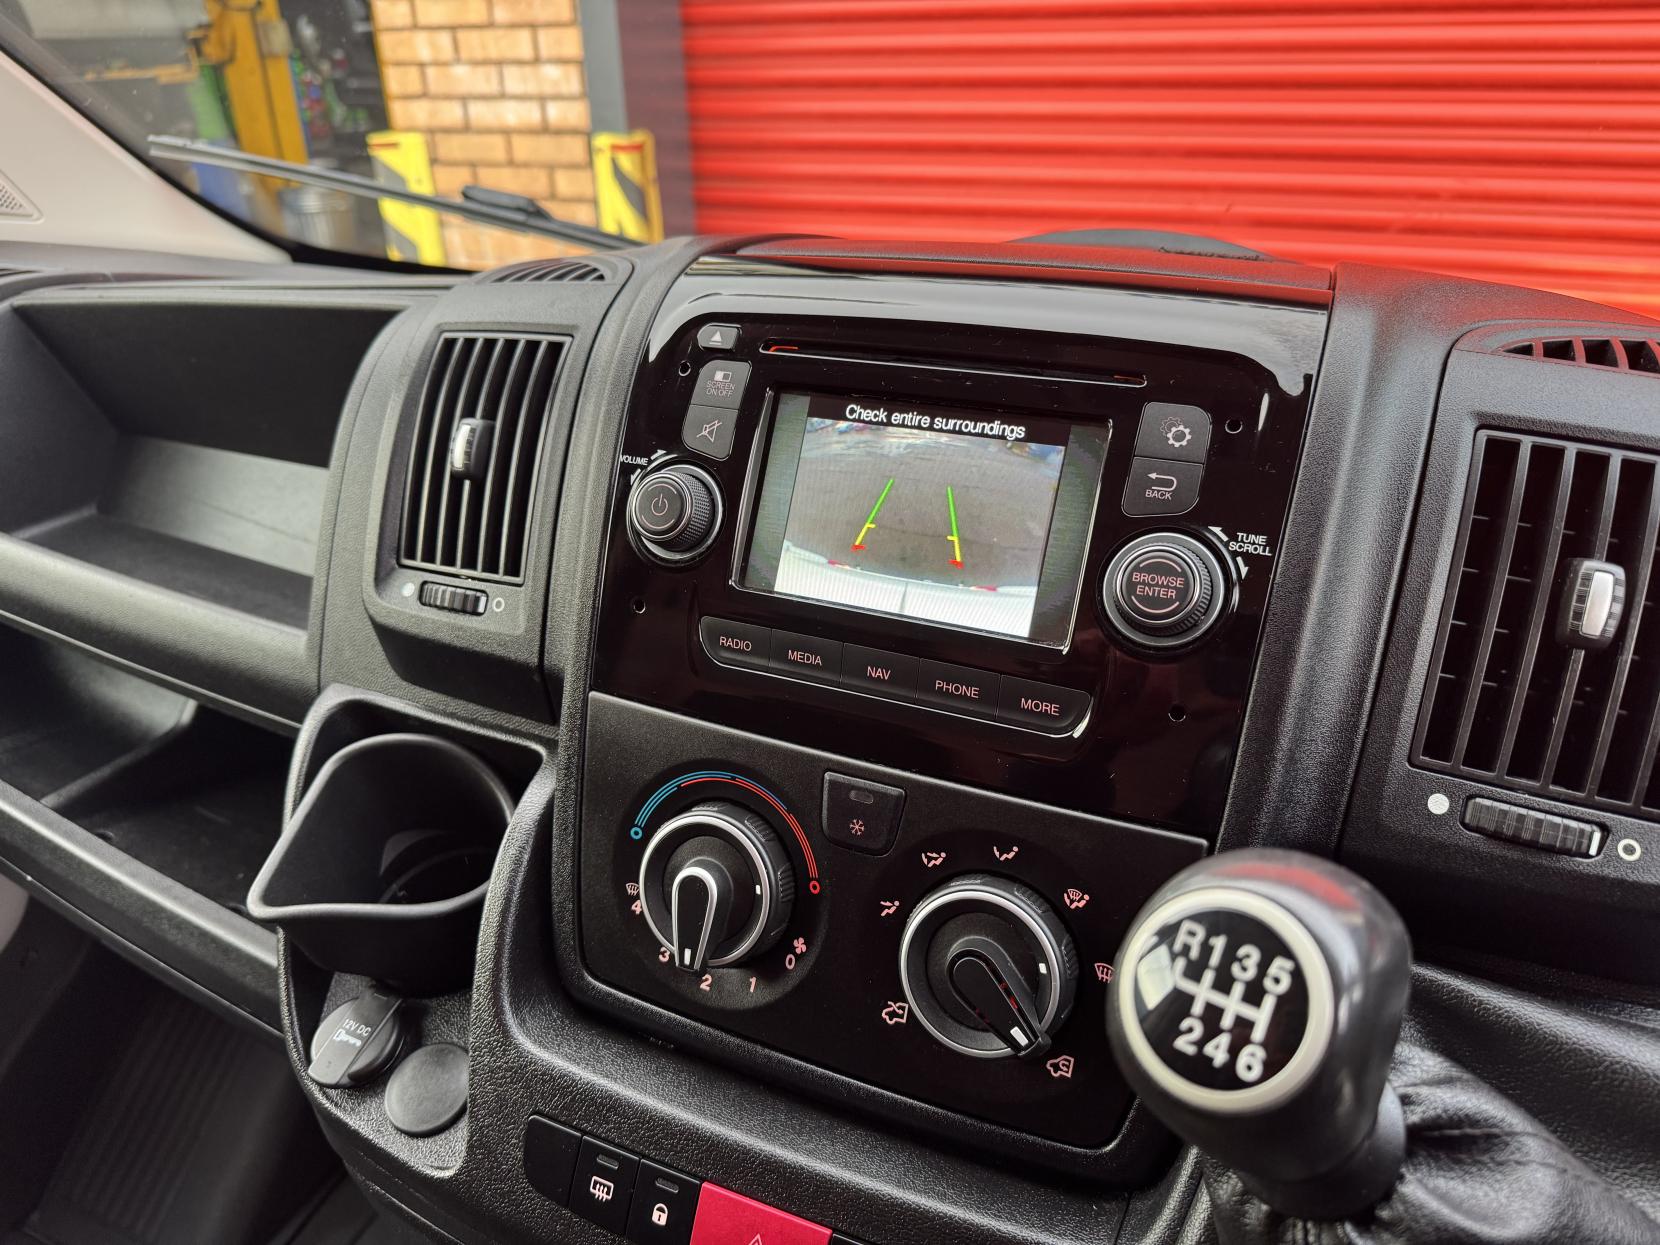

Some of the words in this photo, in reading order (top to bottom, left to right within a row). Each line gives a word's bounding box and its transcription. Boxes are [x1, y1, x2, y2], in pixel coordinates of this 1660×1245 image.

[707, 380, 735, 390] SCREEN
[846, 404, 887, 423] Check
[891, 411, 930, 428] entire
[933, 417, 1026, 440] surroundings
[619, 455, 649, 465] VOLUME
[1145, 489, 1172, 500] BACK
[1236, 532, 1267, 545] TUNE
[1228, 542, 1272, 556] SCROLL
[1132, 572, 1185, 588] BROWSE
[1136, 586, 1176, 599] ENTER
[719, 637, 752, 651] RADIO
[788, 650, 822, 666] MEDIA
[866, 666, 891, 680] NAV
[935, 680, 980, 699] PHONE
[1020, 697, 1061, 716] MORE
[631, 900, 642, 914] 4
[659, 947, 670, 962] 3
[785, 953, 796, 970] 0
[1173, 919, 1206, 960] R
[1208, 934, 1228, 969] 1
[1231, 943, 1262, 983] 3
[1262, 955, 1296, 997] 5
[700, 975, 712, 991] 2
[749, 976, 757, 993] 1
[343, 1019, 359, 1031] 12V
[356, 1024, 372, 1036] DC
[1173, 1017, 1204, 1056] 2
[1203, 1032, 1232, 1068] 4
[1235, 1043, 1267, 1083] 6
